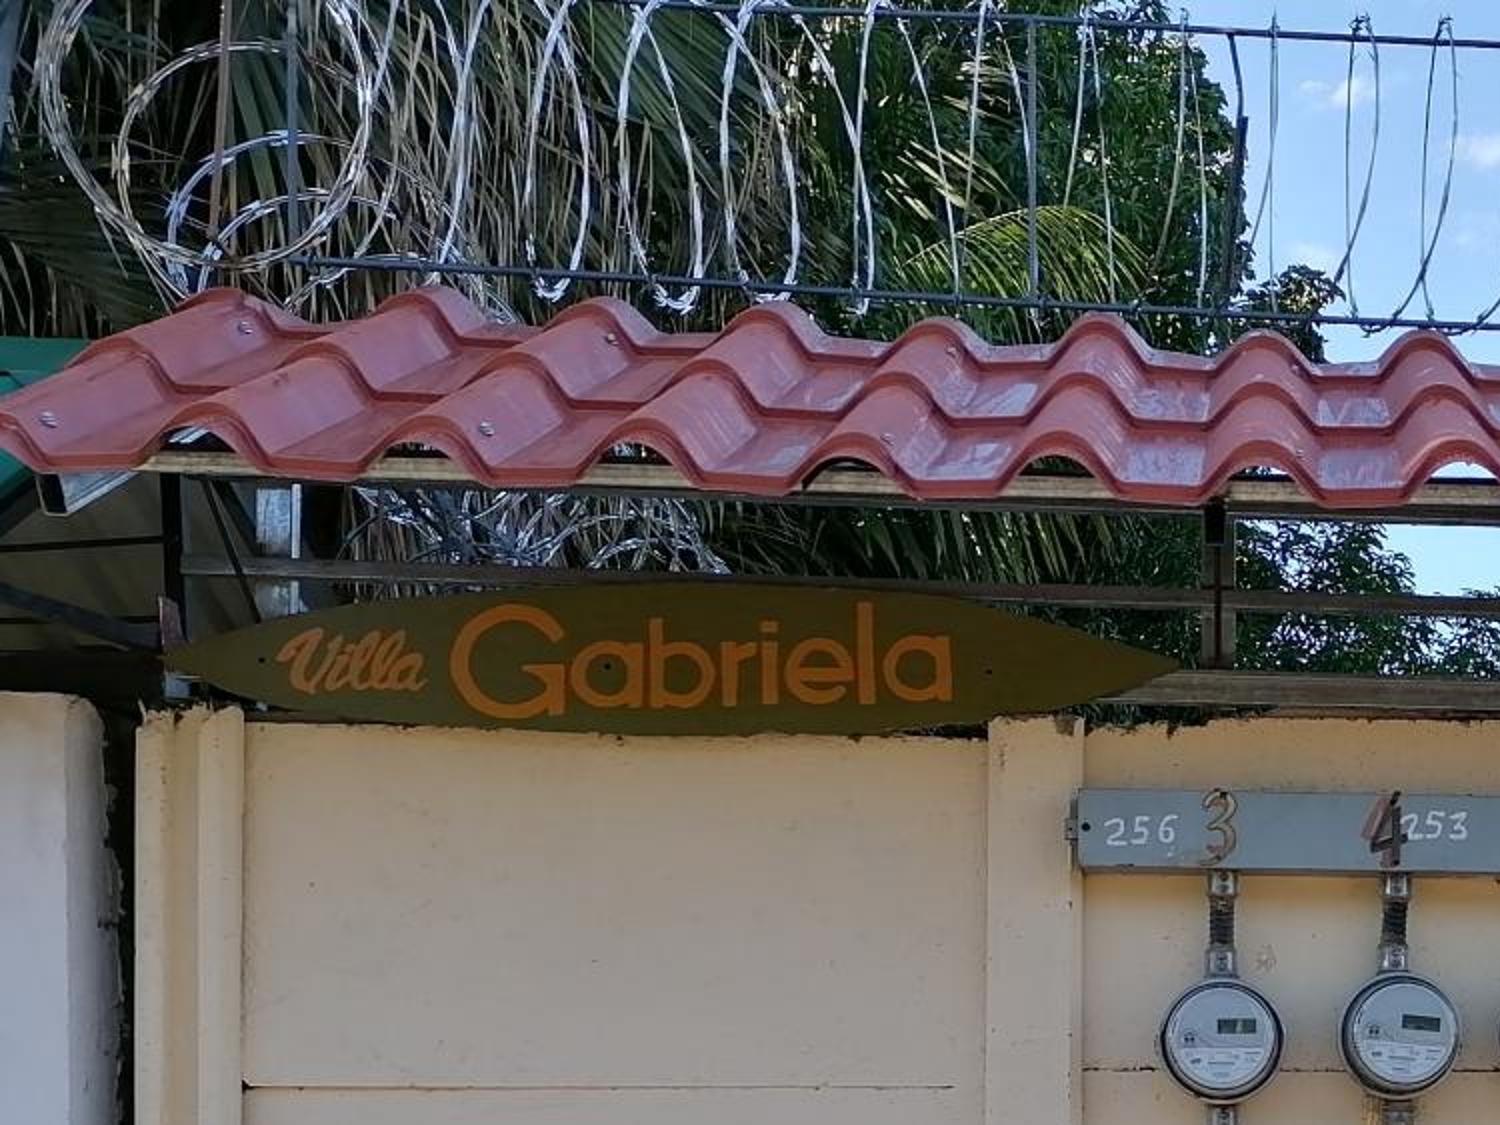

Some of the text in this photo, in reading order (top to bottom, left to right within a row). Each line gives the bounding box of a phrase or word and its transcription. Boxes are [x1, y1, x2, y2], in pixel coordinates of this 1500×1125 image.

[276, 602, 951, 718] Villa Gabriela
[1104, 814, 1177, 847] 256
[1202, 788, 1237, 866] 3
[1361, 791, 1405, 868] 4
[1399, 811, 1469, 842] 253
